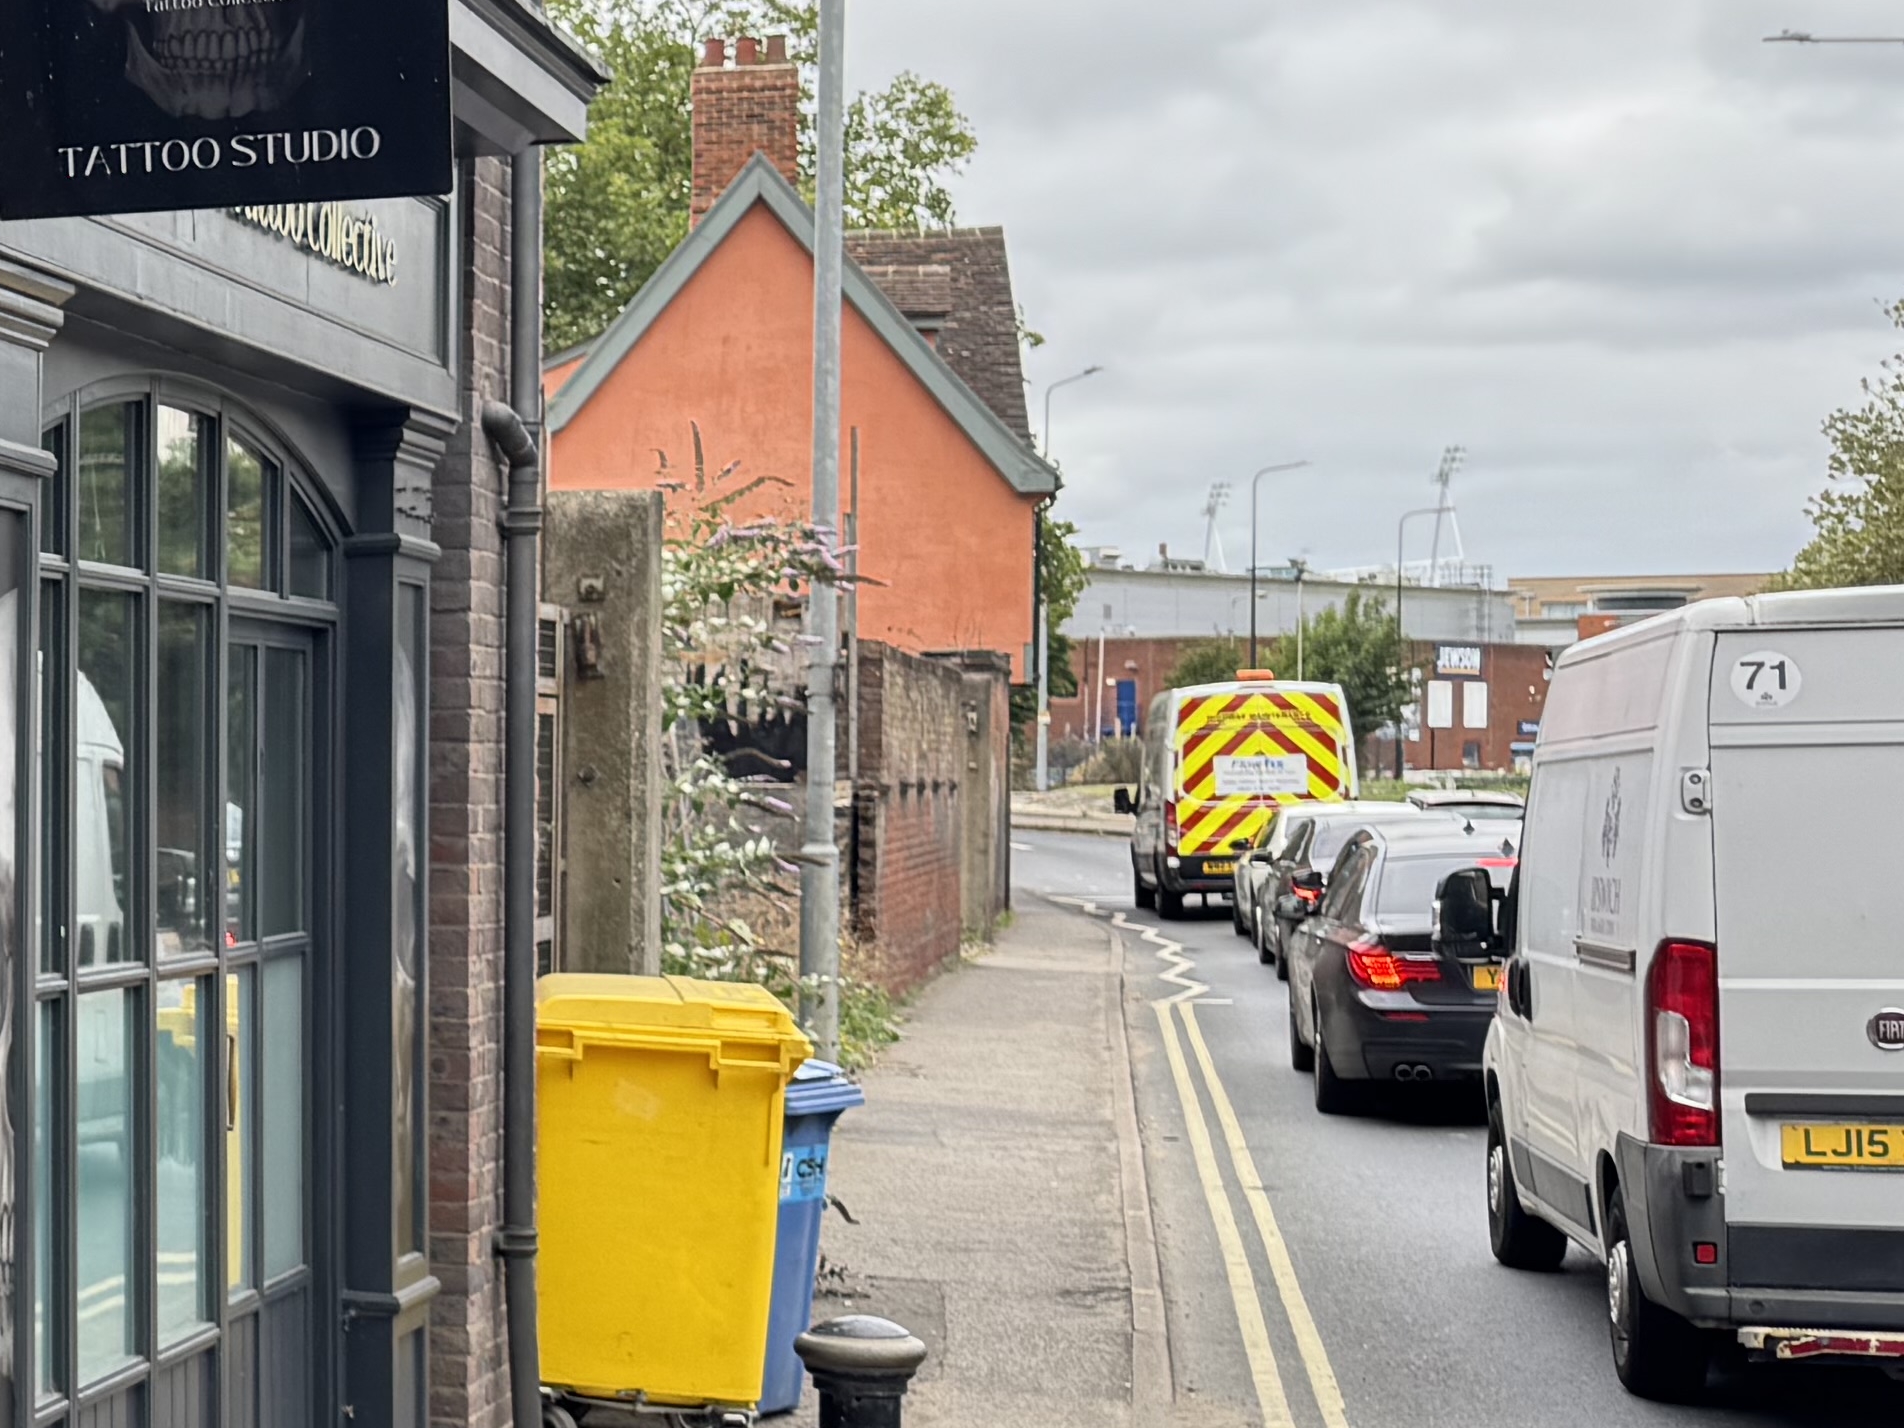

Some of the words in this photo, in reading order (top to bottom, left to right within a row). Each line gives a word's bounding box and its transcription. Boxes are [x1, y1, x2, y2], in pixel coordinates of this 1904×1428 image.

[58, 137, 221, 178] TATTOO
[230, 126, 380, 167] STUDIO
[307, 200, 397, 287] Collective
[1740, 660, 1786, 690] 71
[1804, 1128, 1889, 1158] LJ15
